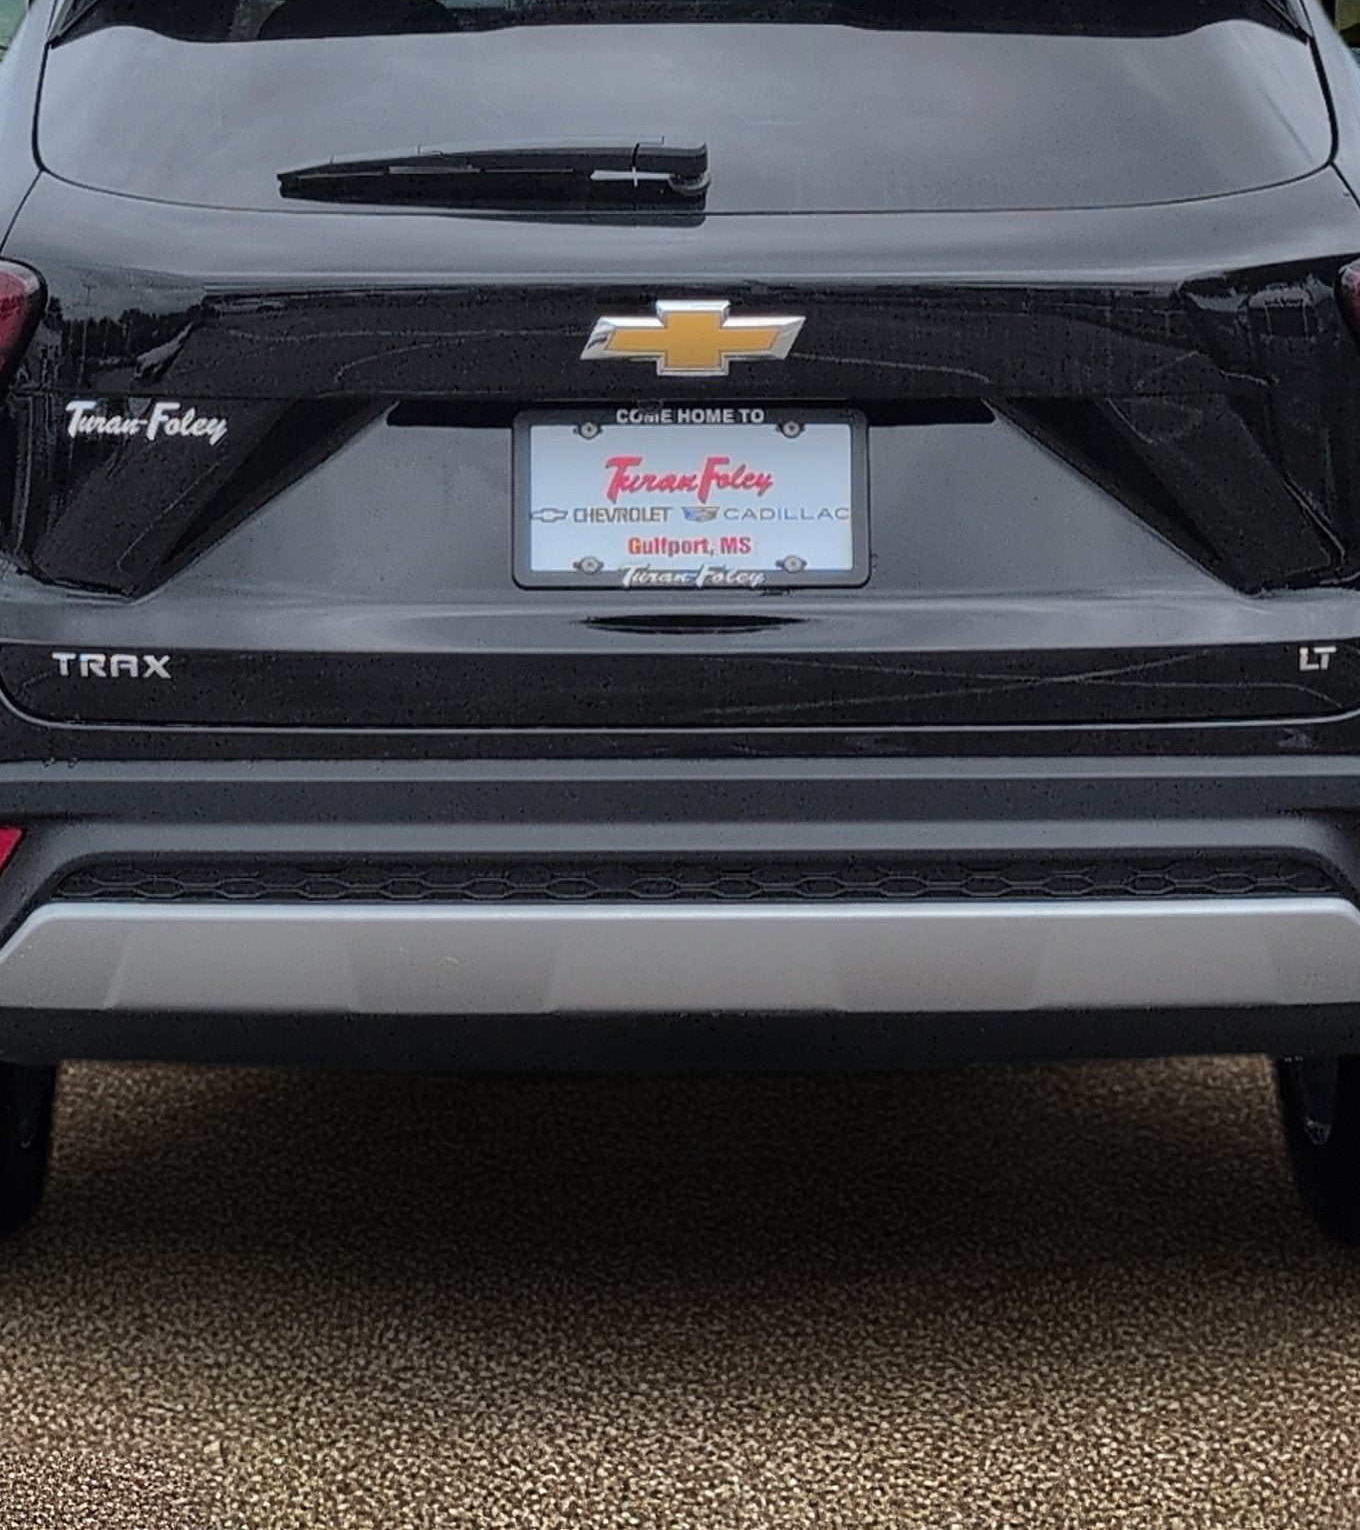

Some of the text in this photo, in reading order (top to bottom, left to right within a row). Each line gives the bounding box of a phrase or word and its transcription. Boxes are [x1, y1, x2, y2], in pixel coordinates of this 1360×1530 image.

[65, 400, 228, 446] Turan Foley
[616, 408, 765, 424] COME HOME TO
[605, 456, 773, 504] Turan Foley
[573, 507, 849, 523] CHEVROLET CADILLAC
[628, 536, 752, 557] Gulfport, MS
[695, 563, 765, 587] Foley
[51, 651, 172, 679] TRAX
[1299, 645, 1337, 672] LT
